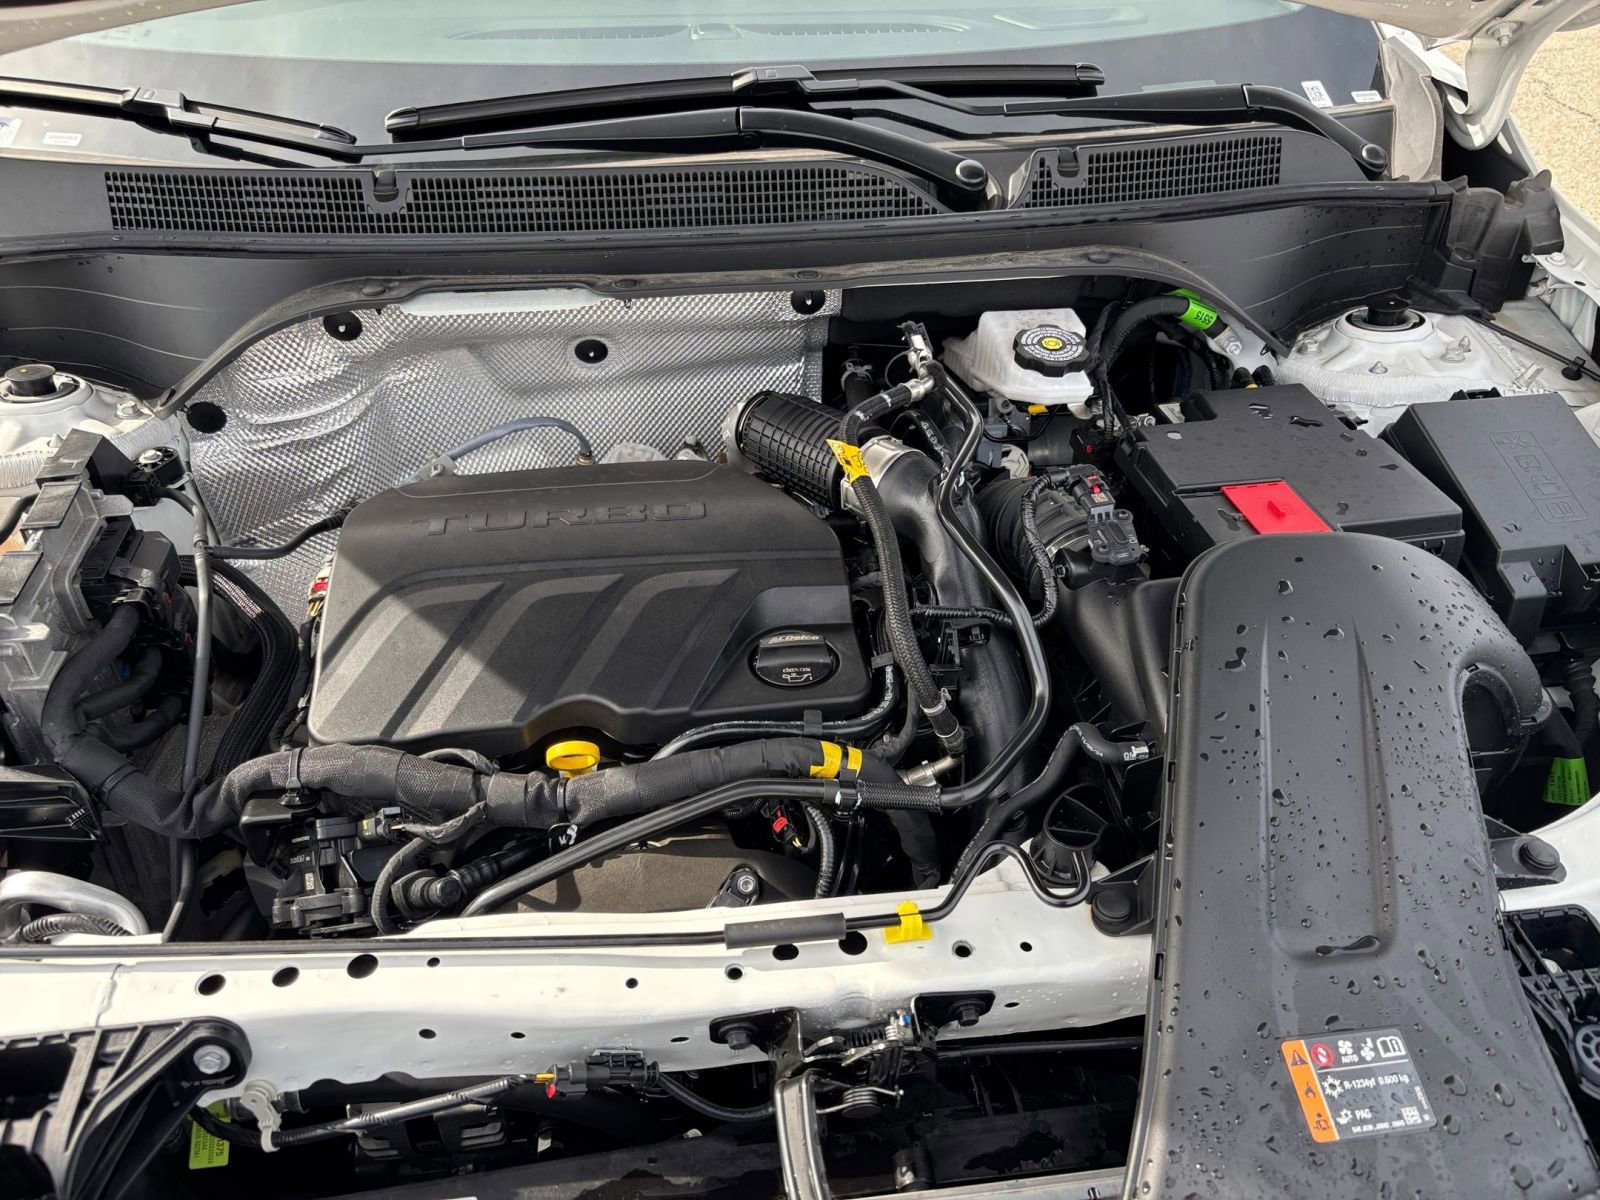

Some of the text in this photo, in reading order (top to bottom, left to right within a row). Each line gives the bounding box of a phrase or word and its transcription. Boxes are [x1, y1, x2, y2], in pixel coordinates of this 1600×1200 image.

[411, 502, 708, 536] TURBO
[1341, 1054, 1359, 1064] AUTO
[1343, 1074, 1410, 1090] R-1234yf 0.600 kg
[1355, 1108, 1372, 1120] PAG
